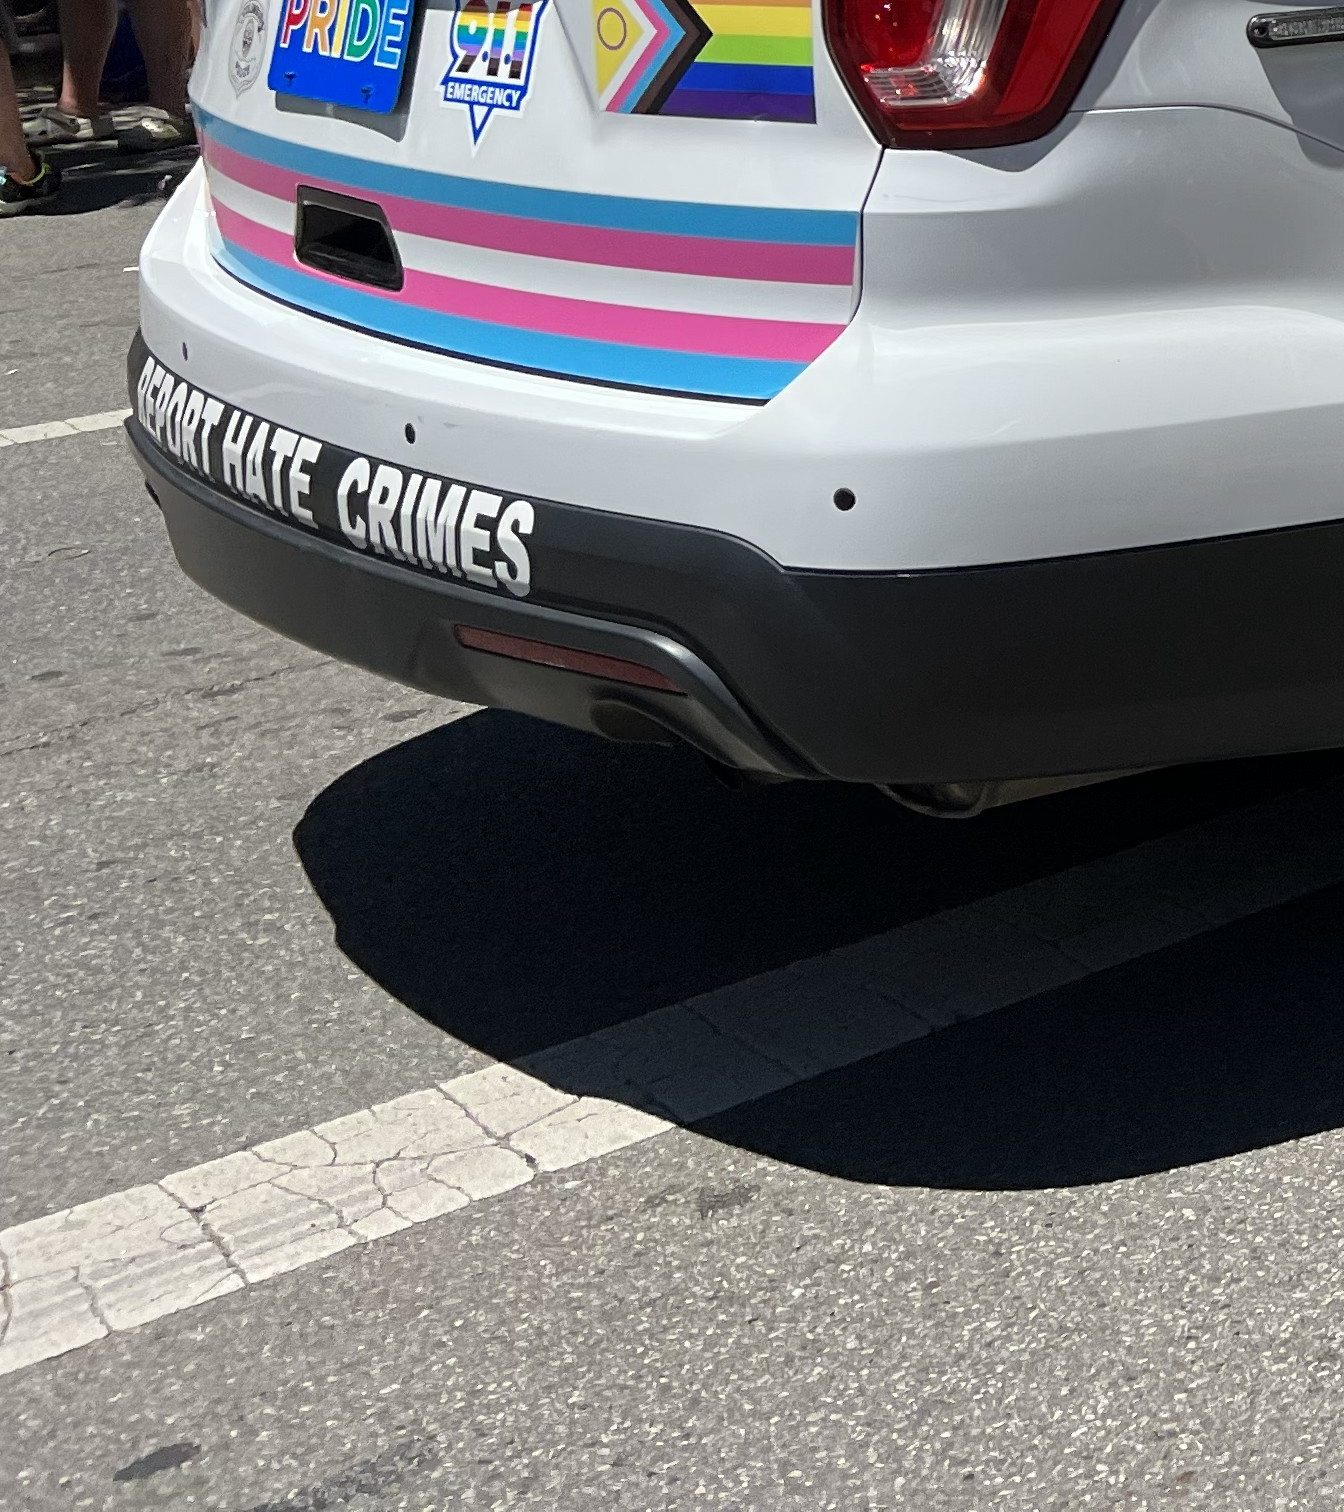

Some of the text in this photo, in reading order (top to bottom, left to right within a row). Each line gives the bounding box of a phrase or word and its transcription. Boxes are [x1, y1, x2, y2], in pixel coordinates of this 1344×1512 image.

[446, 81, 521, 107] EMERGENCY
[137, 356, 535, 597] REPORT HATE CRIMES
